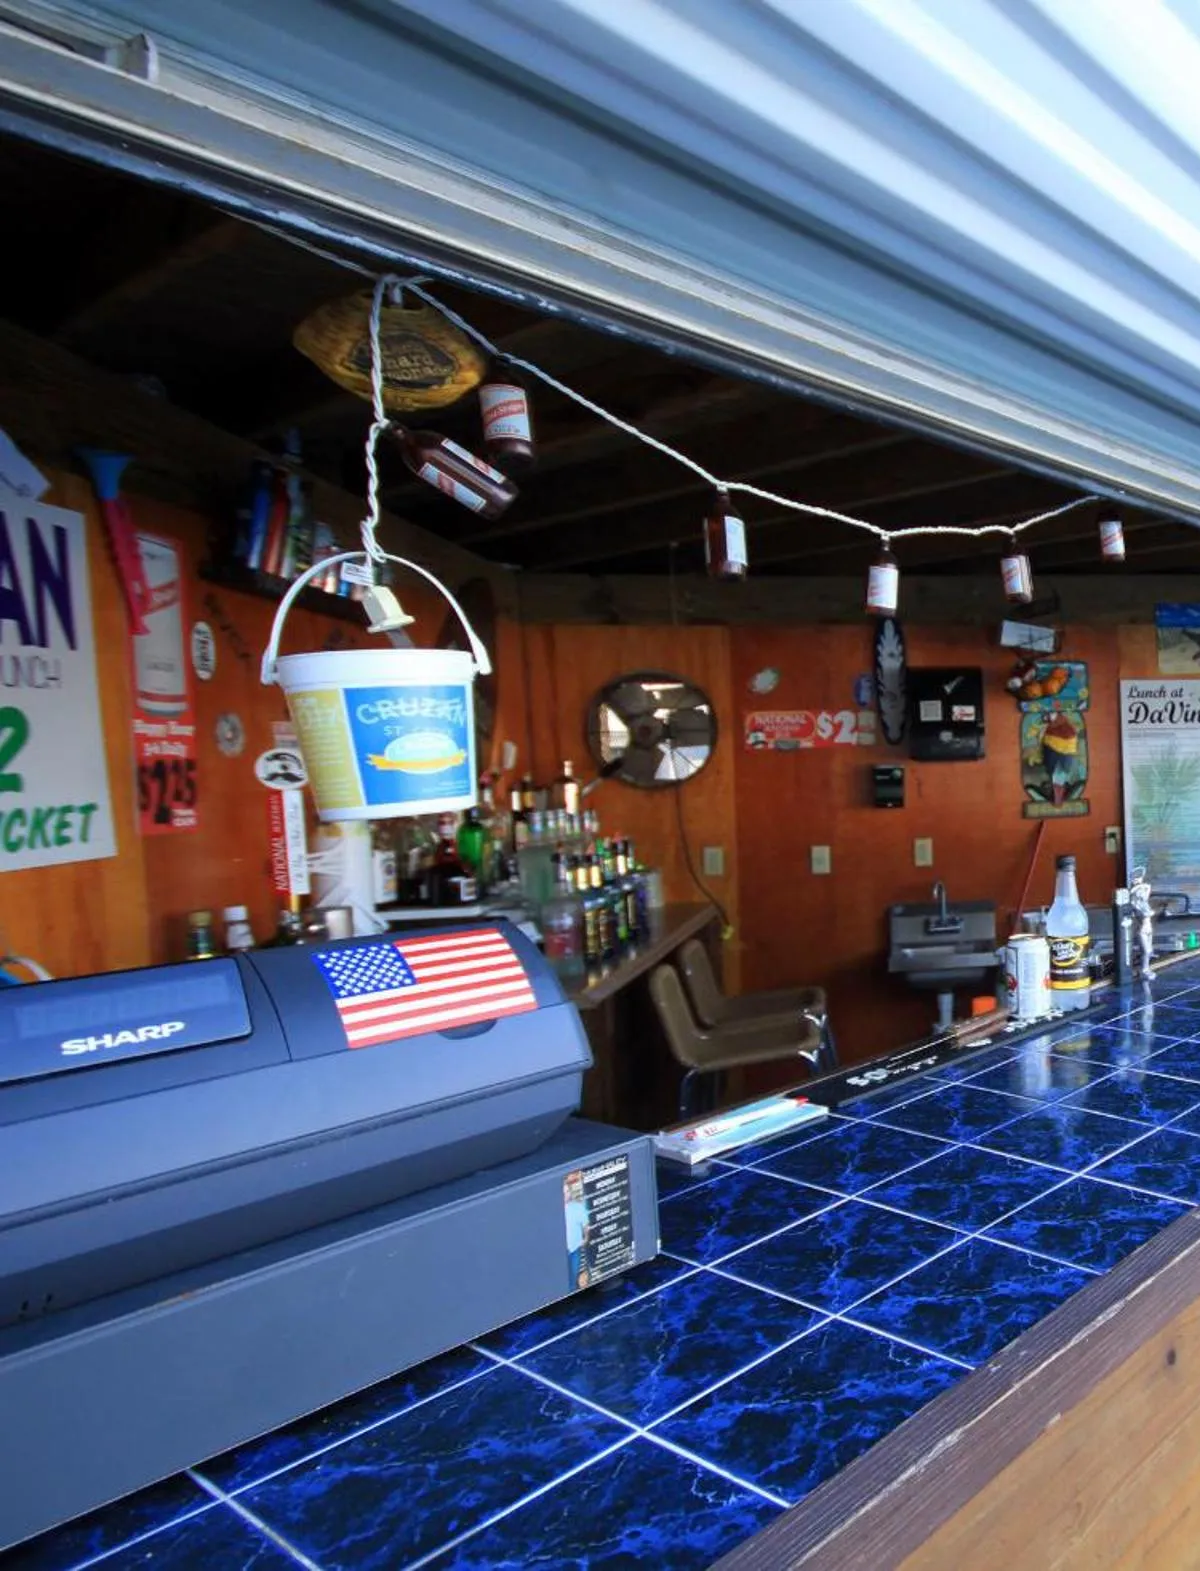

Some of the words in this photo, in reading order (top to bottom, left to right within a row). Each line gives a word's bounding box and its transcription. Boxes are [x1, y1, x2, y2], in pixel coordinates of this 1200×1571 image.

[1127, 685, 1167, 699] Lunch
[1170, 686, 1185, 699] at
[356, 696, 466, 728] CRUZAN
[0, 803, 98, 853] CKET
[271, 837, 288, 890] NATIONAL
[60, 1021, 186, 1056] SHARP
